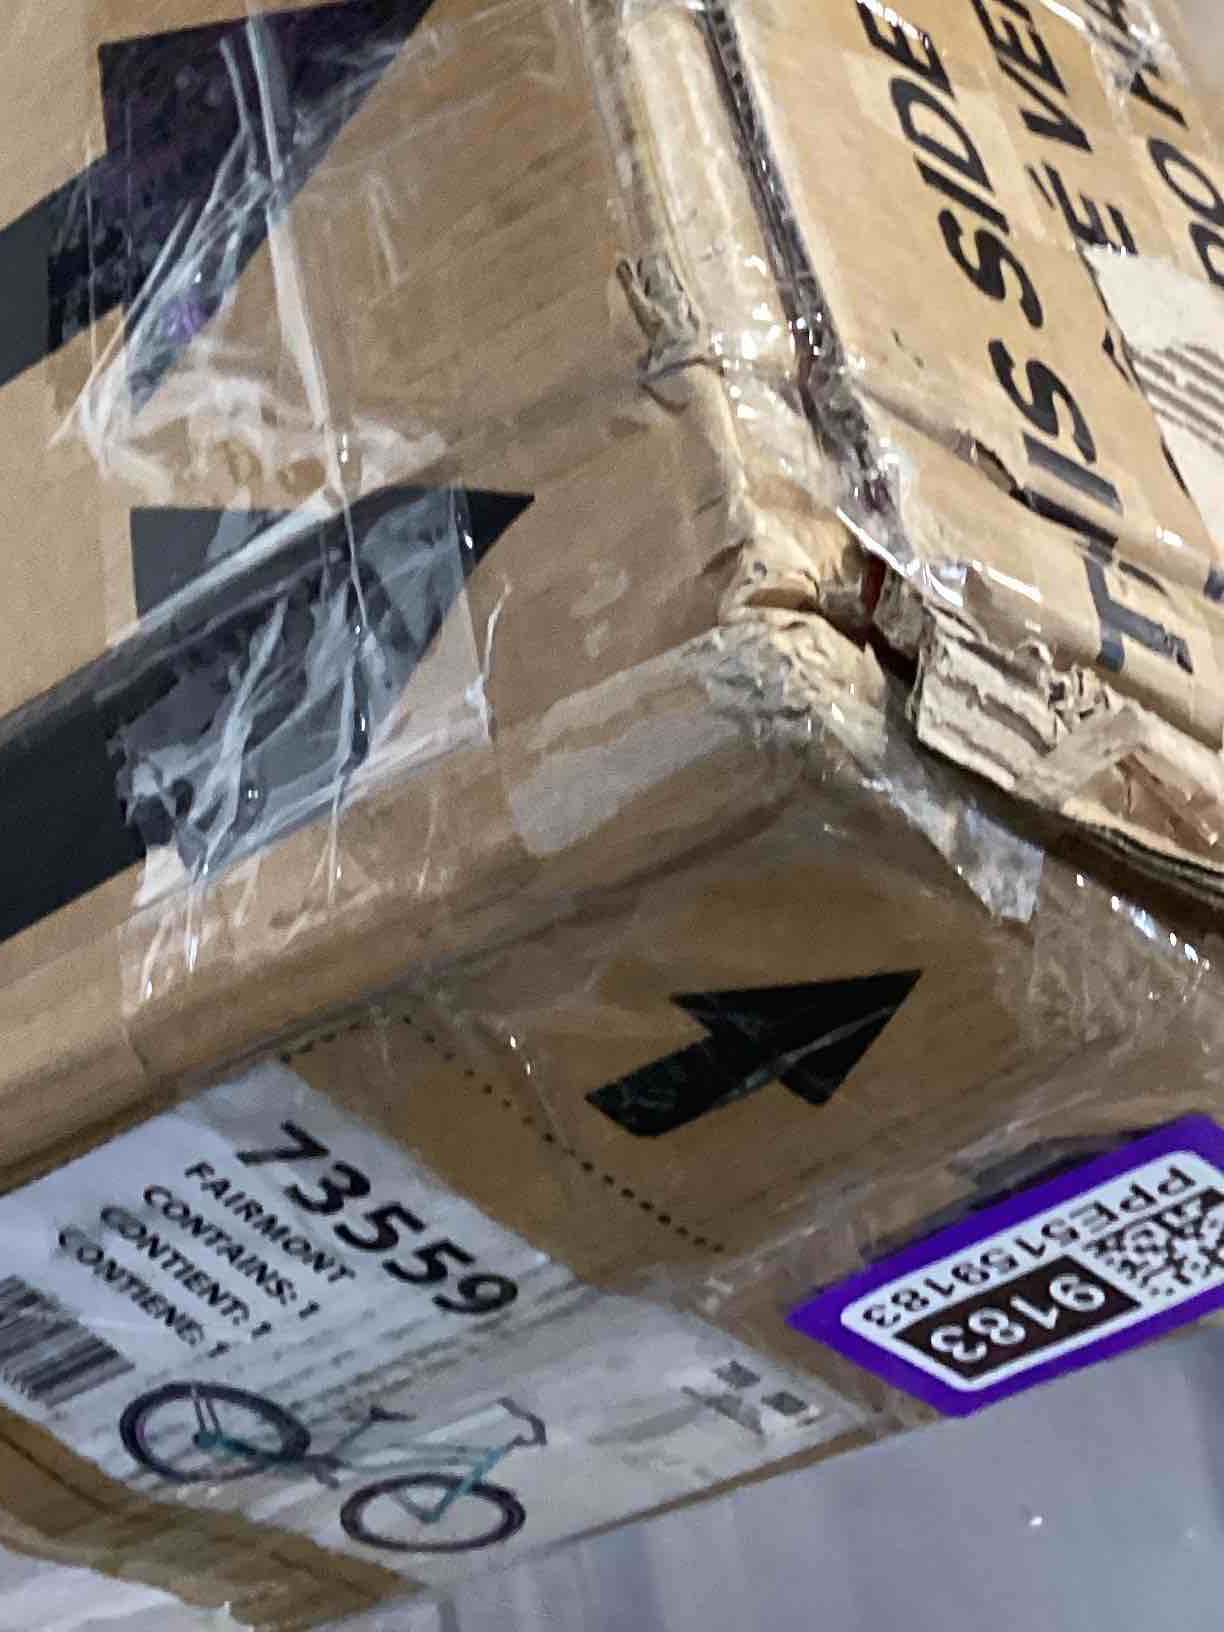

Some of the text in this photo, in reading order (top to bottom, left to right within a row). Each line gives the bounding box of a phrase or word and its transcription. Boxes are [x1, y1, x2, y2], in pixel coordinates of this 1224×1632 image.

[987, 336, 1195, 676] THIS
[100, 1204, 251, 1327] CONTIENT:
[142, 1183, 298, 1306] CONTAINS:
[184, 1160, 356, 1284] FAIRMONT
[235, 1120, 519, 1316] 73559
[861, 1165, 1197, 1329] PPE5159183
[929, 1271, 1107, 1364] 9183
